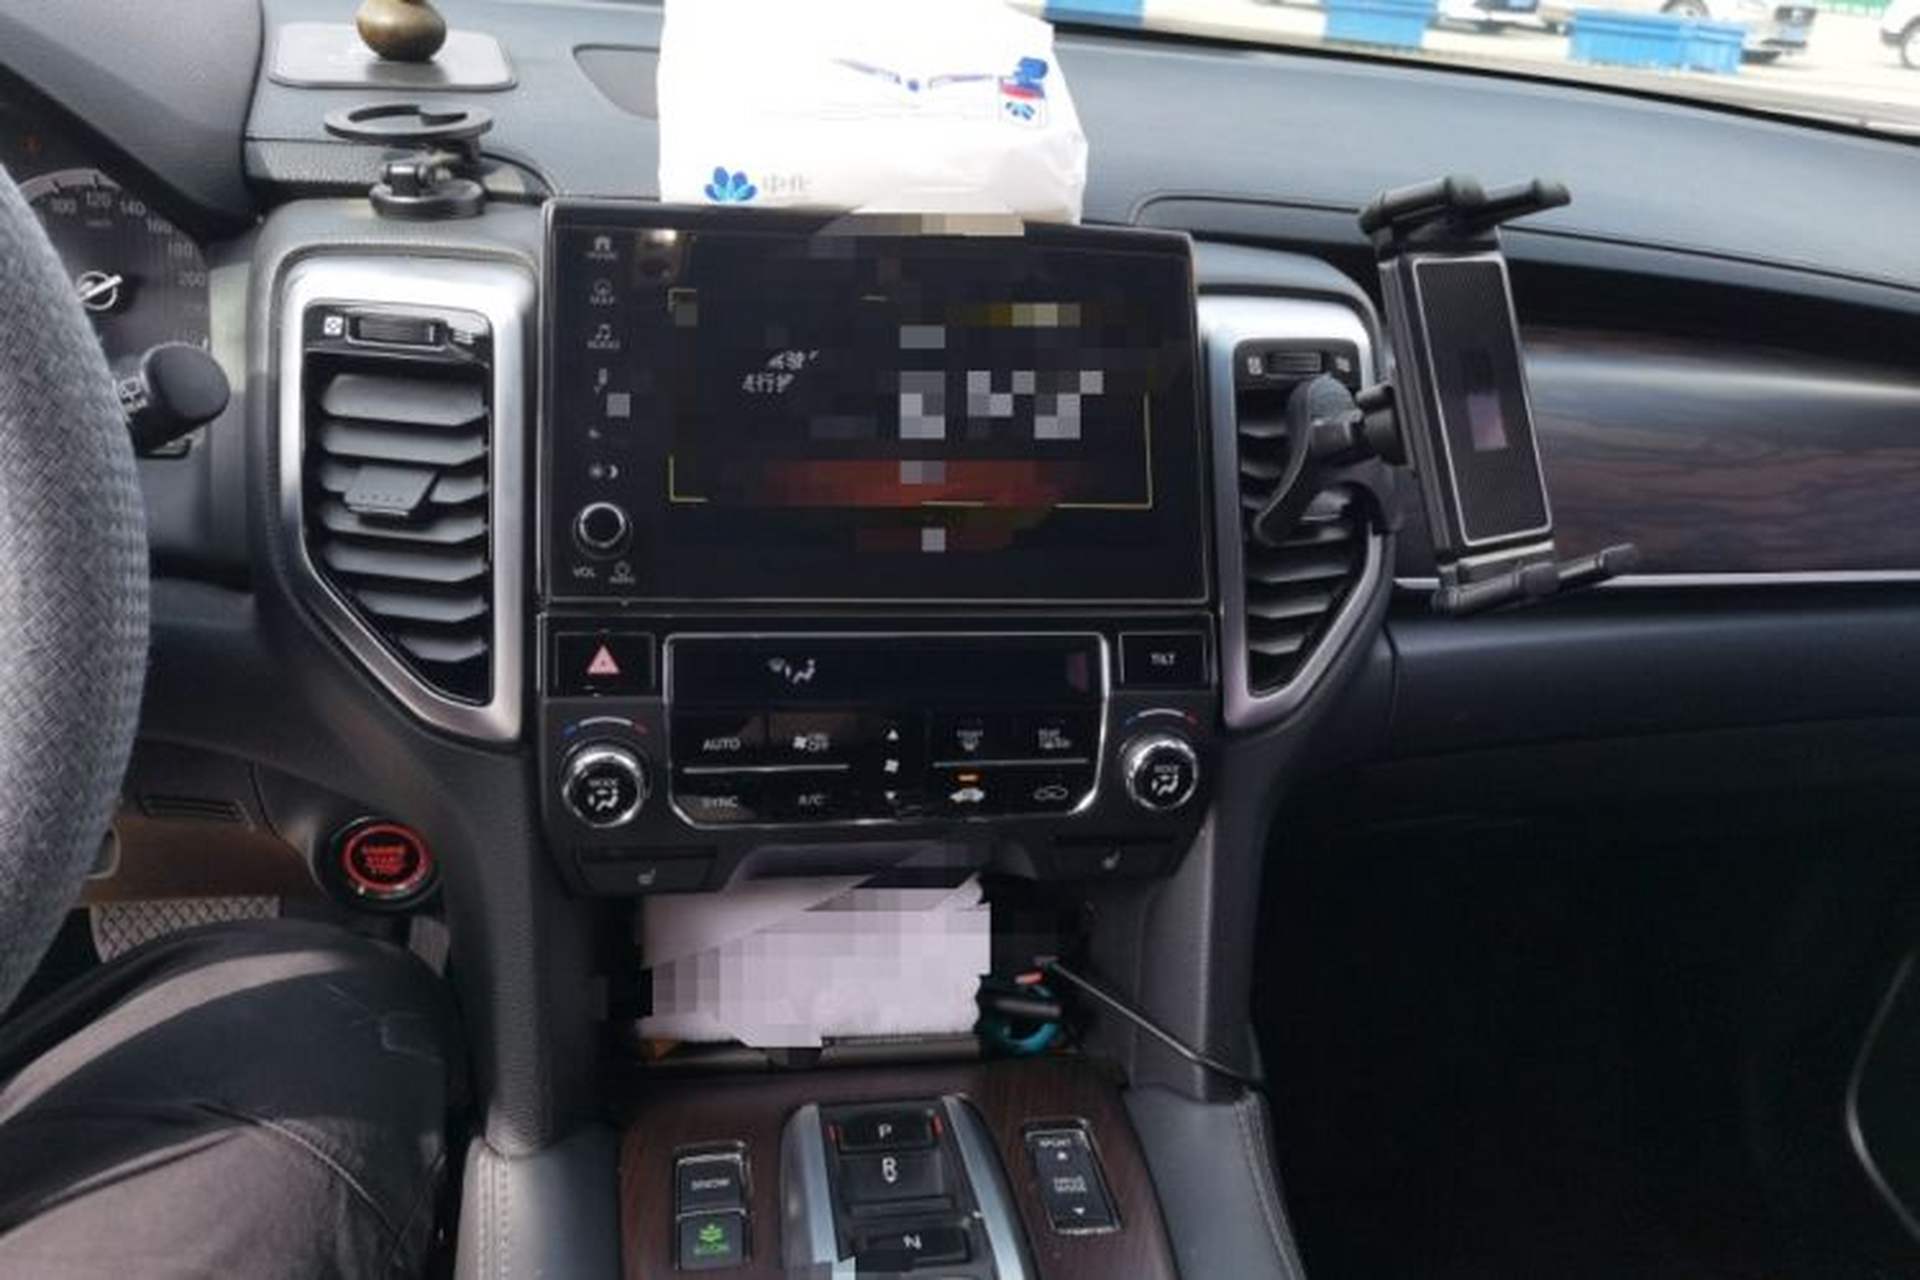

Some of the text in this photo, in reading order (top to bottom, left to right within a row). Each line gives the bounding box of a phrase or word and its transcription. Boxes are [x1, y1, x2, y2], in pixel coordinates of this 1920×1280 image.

[120, 200, 146, 217] 140
[703, 737, 741, 751] AUTO
[878, 1123, 893, 1139] P
[903, 1234, 922, 1249] N
